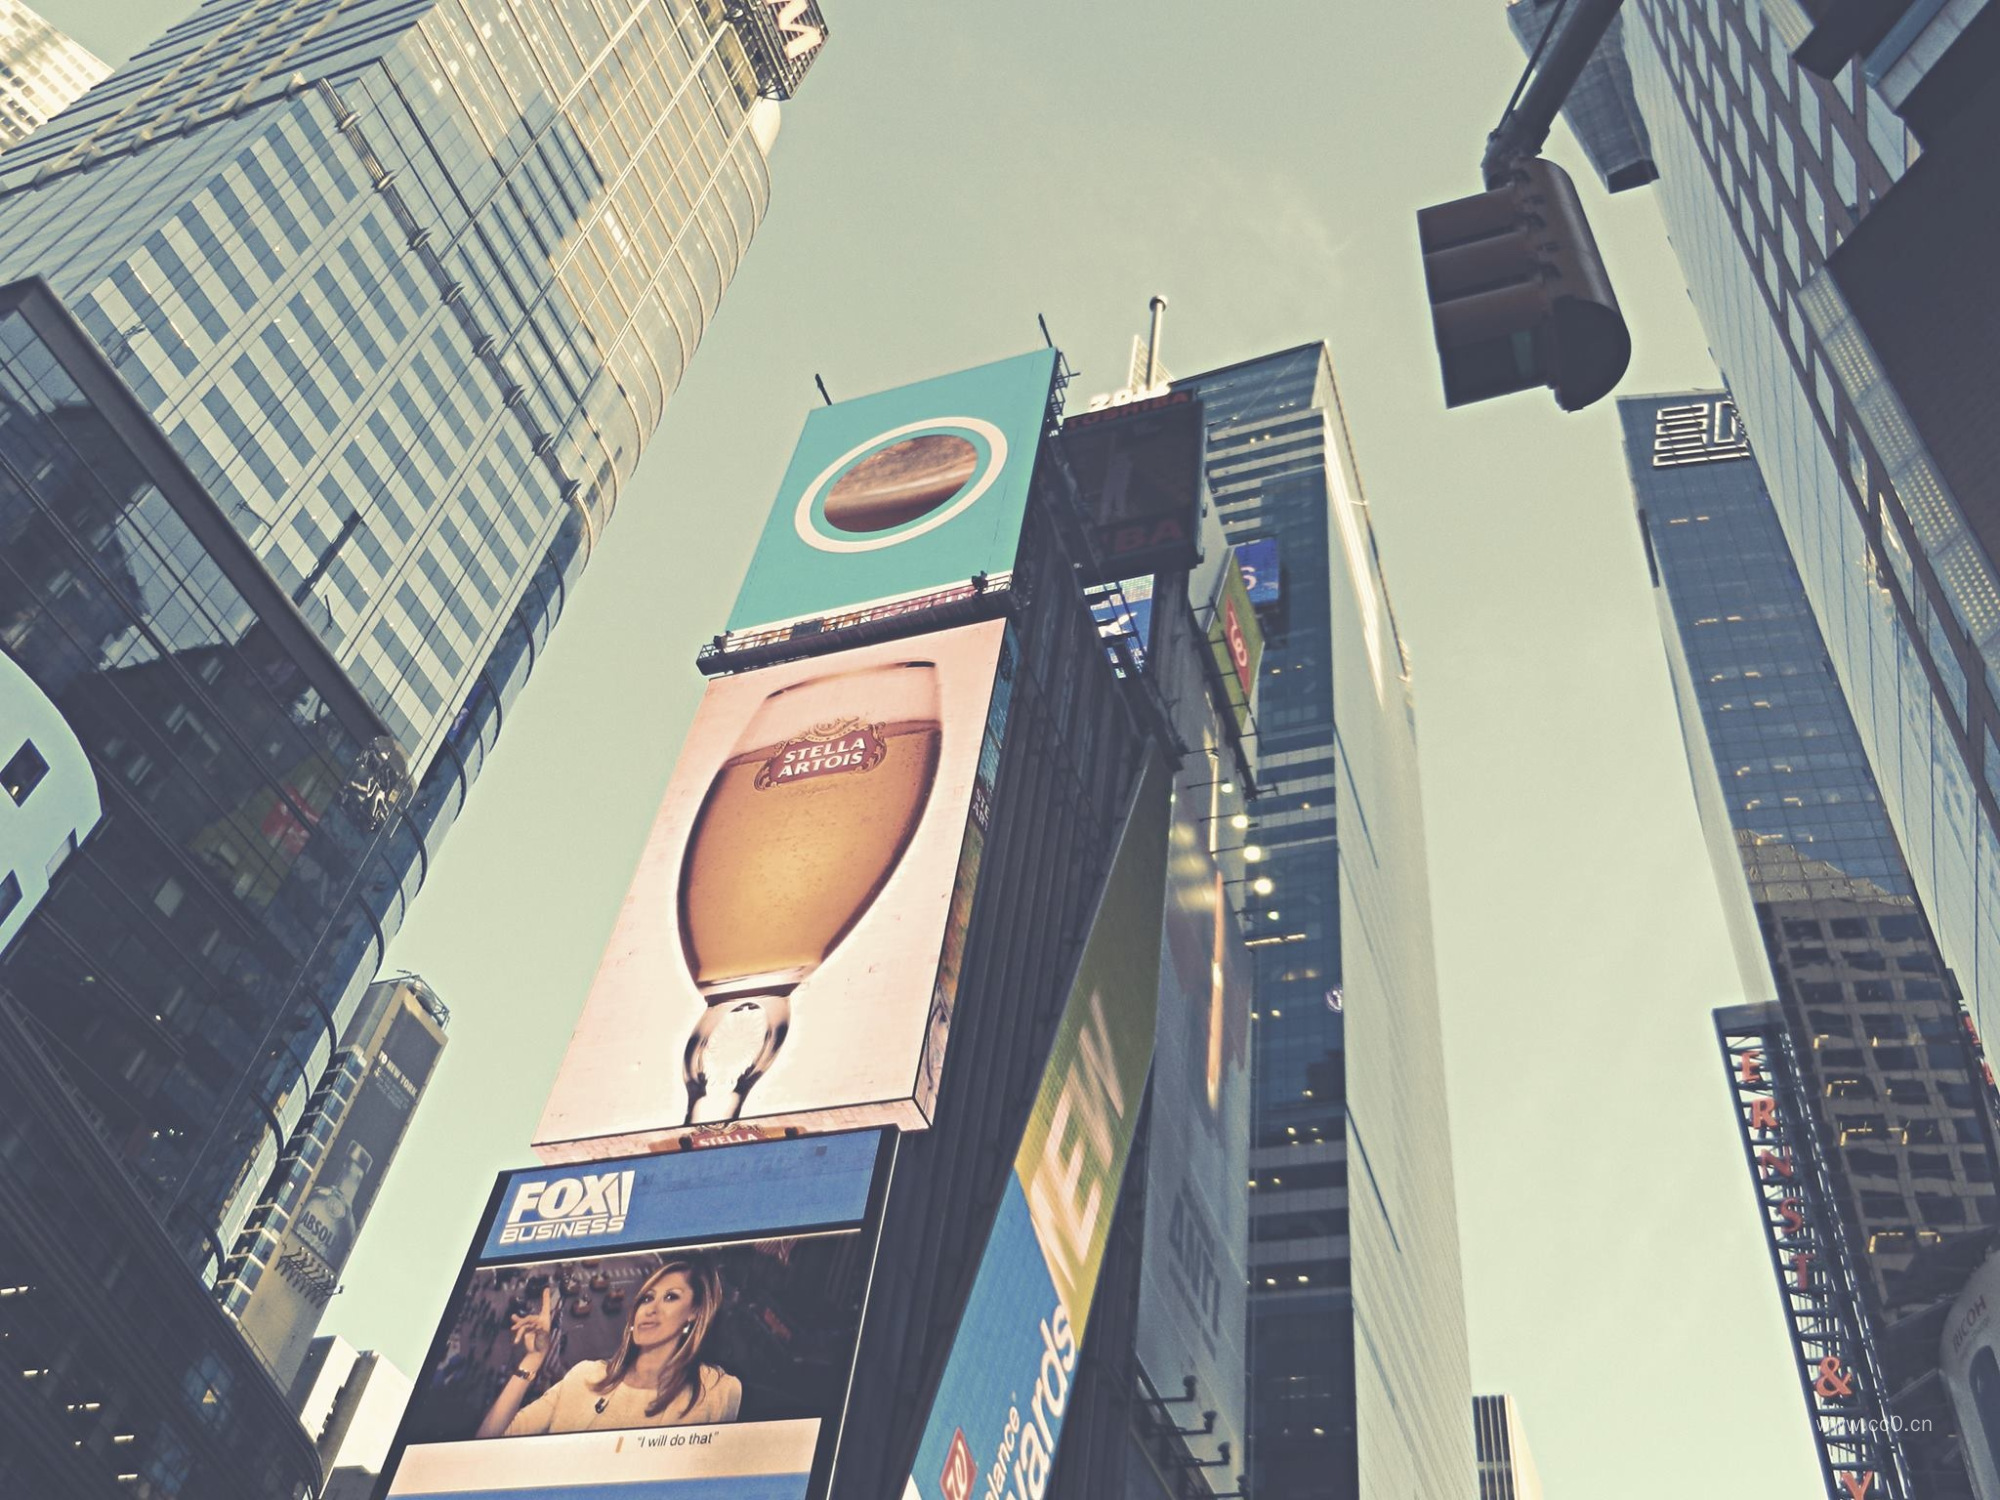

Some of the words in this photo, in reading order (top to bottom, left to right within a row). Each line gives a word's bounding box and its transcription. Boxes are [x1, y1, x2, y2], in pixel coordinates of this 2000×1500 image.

[784, 738, 866, 763] STELLA
[778, 752, 863, 778] ARTOIS
[699, 1133, 758, 1147] STELLA
[507, 1170, 636, 1223] FOX
[500, 1215, 625, 1244] BUSINESS
[1741, 1050, 1816, 1290] ERNST
[1815, 1356, 1852, 1398] &
[1953, 1295, 1987, 1354] RICOH
[648, 1434, 668, 1447] will
[670, 1434, 686, 1447] do
